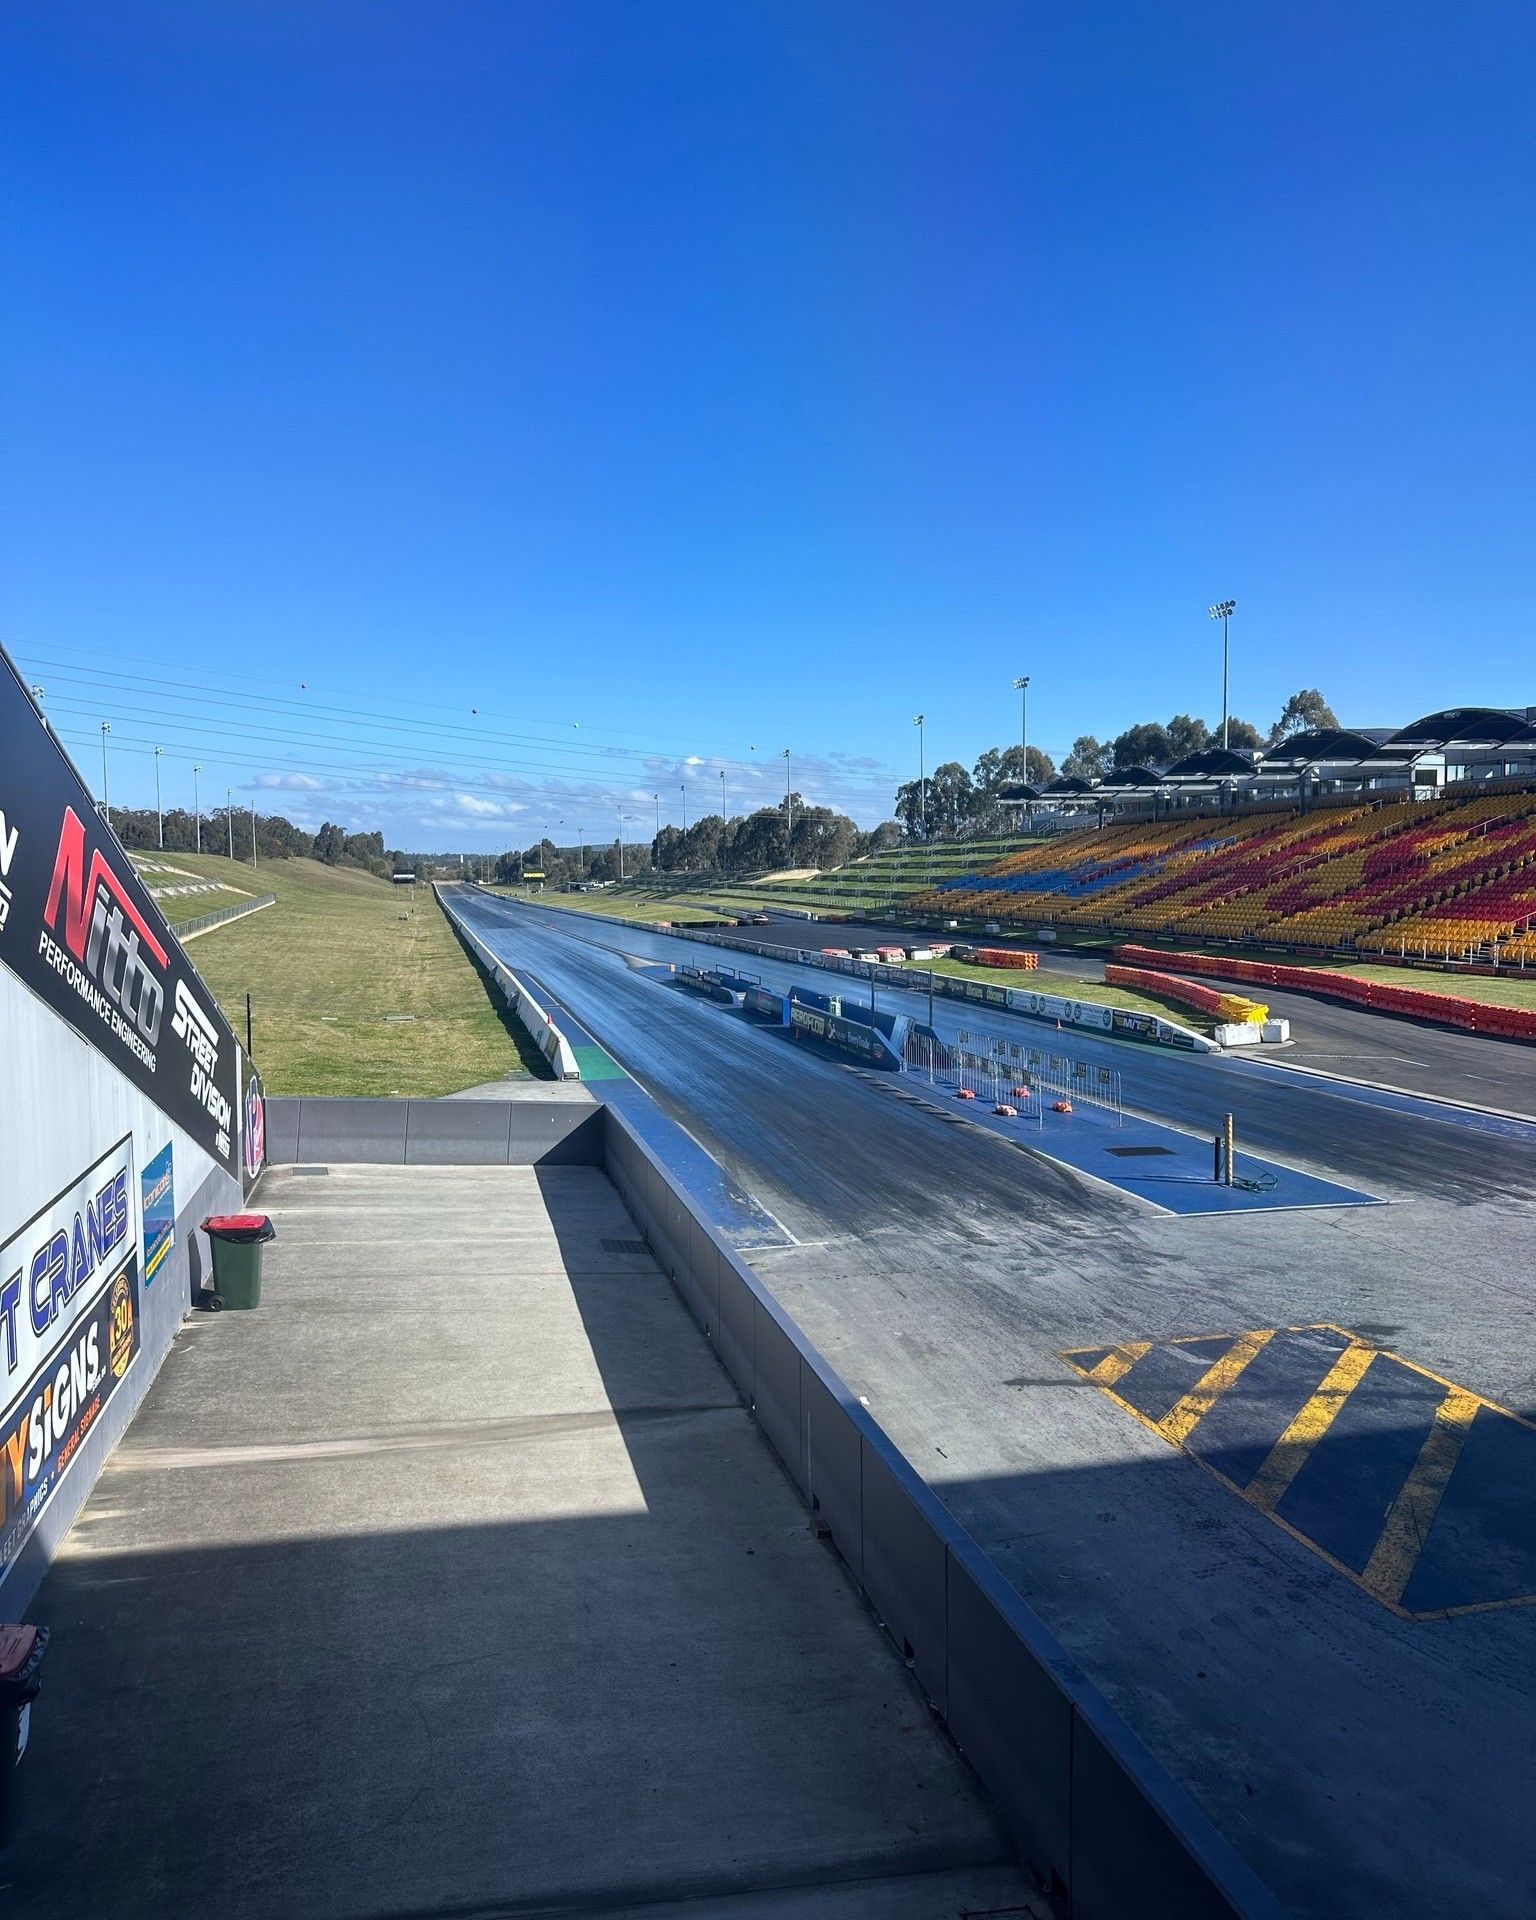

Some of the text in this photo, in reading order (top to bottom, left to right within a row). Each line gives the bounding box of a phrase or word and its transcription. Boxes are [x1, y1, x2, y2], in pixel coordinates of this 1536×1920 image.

[44, 805, 169, 1047] Nitto
[38, 930, 157, 1074] PERFORMANCE ENGINEERING
[171, 978, 220, 1078] STREET
[791, 1007, 825, 1036] AEROFLOW
[190, 1062, 232, 1133] DIVISION
[29, 1165, 128, 1338] CRANES
[114, 1298, 128, 1341] 30
[17, 1476, 48, 1537] GRAPHICS
[58, 1426, 80, 1473] GENERAL
